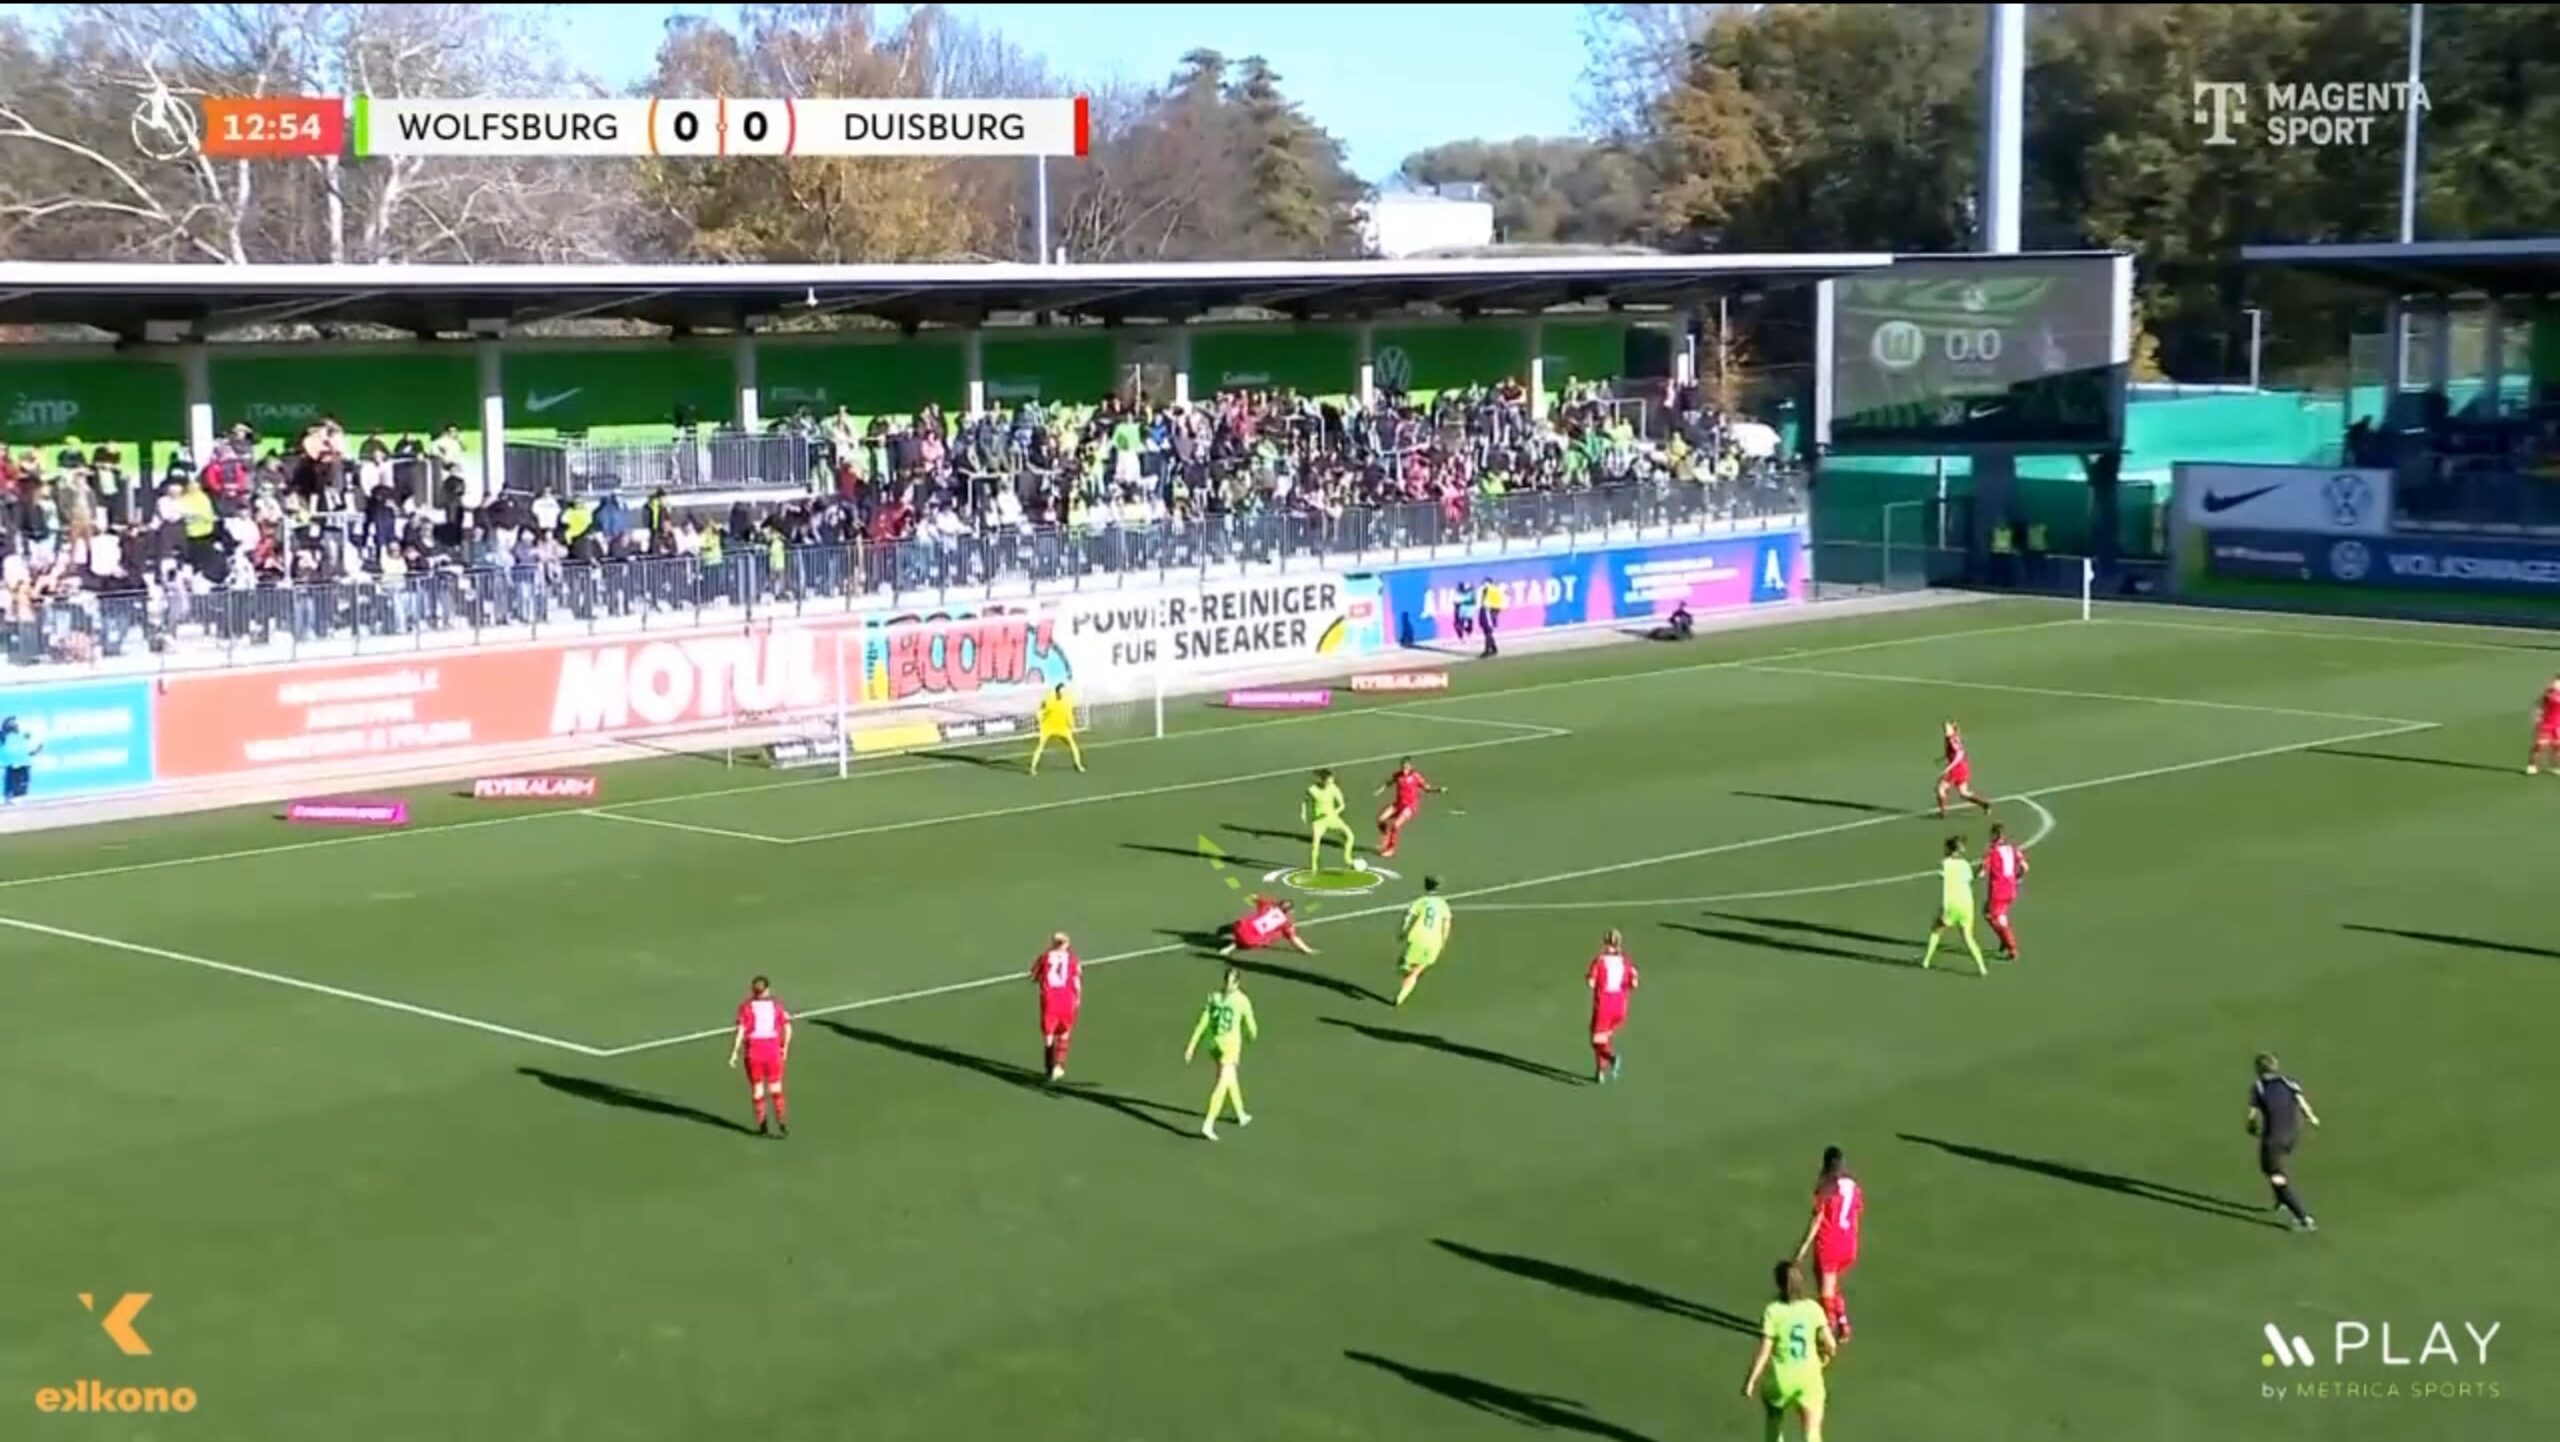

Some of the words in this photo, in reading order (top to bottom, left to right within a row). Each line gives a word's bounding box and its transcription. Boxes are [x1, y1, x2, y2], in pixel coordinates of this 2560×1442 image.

[1072, 583, 1337, 636] POWER-REINIGER
[1174, 619, 1307, 661] SNEAKER
[551, 629, 825, 734] MOTUL
[1789, 1324, 1807, 1359] 5
